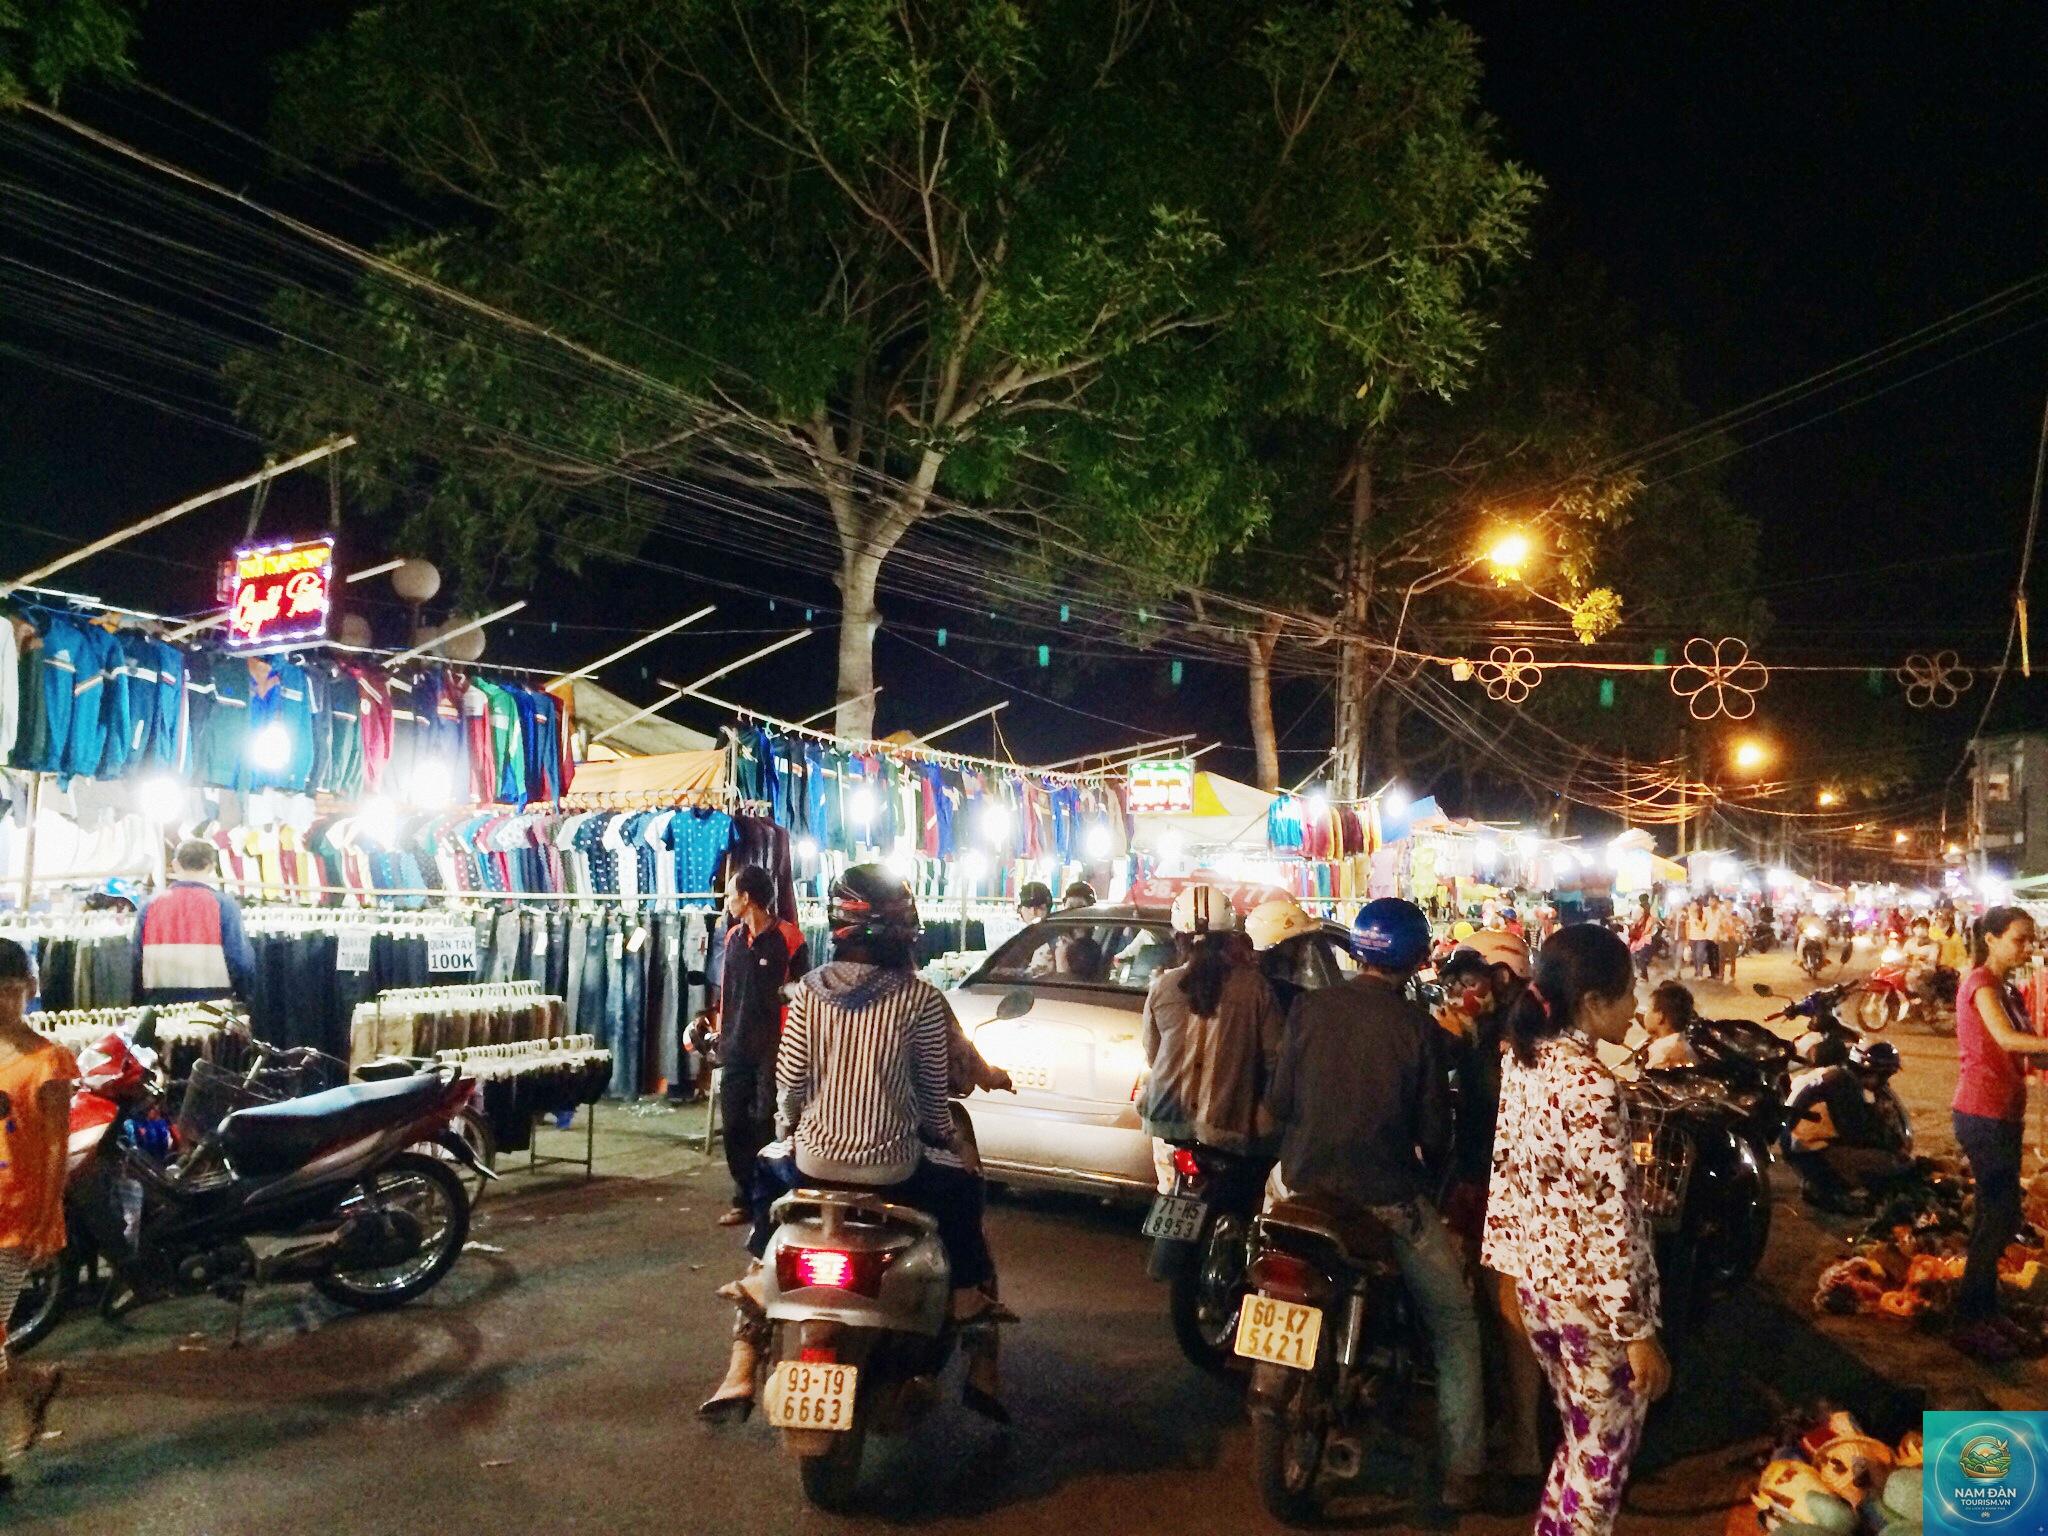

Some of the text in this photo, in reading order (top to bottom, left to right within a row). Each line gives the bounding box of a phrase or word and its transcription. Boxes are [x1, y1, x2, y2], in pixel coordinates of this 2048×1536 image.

[431, 953, 474, 969] 100K
[1152, 1215, 1195, 1238] 8953
[1253, 1301, 1310, 1334] 60-K7
[788, 1367, 845, 1396] 93-T9
[784, 1395, 842, 1424] 6663
